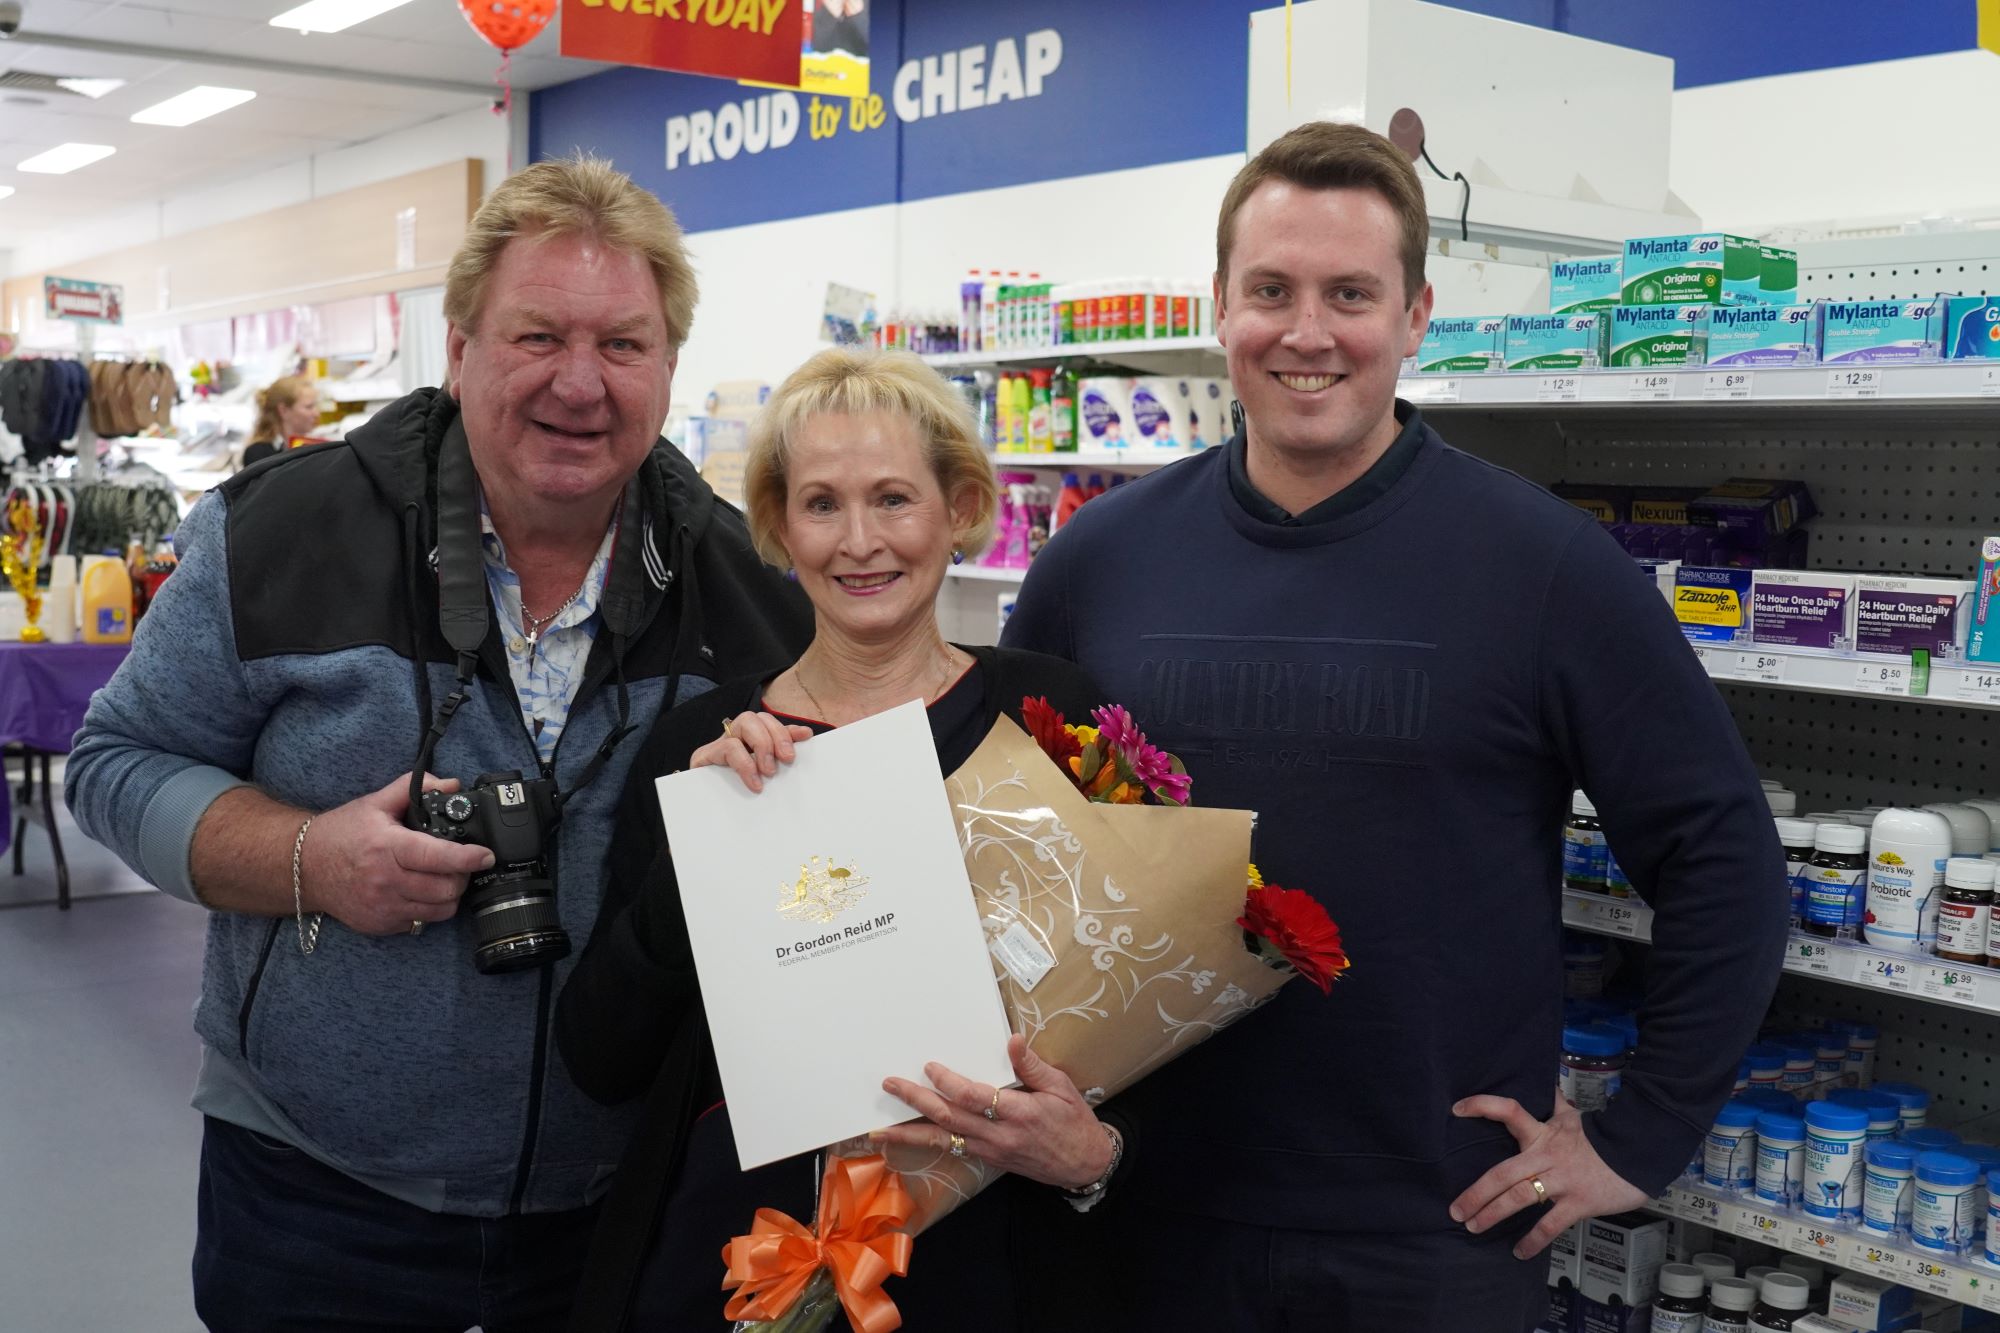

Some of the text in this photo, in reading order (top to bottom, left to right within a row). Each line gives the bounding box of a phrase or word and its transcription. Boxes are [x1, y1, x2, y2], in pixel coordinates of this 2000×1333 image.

[666, 29, 1063, 170] PROUD to be CHEAP
[1629, 240, 1688, 259] Mylanta
[1690, 238, 1719, 254] 2go
[1555, 262, 1612, 280] Mylanta
[1663, 273, 1701, 285] Original
[1616, 308, 1675, 326] Mylanta
[1713, 307, 1809, 330] Mylanta 2go
[1829, 302, 1936, 324] Mylanta 2go
[1427, 319, 1500, 339] Mylanta 2go
[1510, 317, 1593, 336] Mylanta 2go
[1636, 321, 1668, 331] ANTACID
[1735, 323, 1769, 332] ANTACID
[1852, 318, 1891, 329] ANTACID
[1652, 342, 1688, 354] Original
[1552, 379, 1574, 390] 12.99
[1644, 377, 1668, 388] 14.99
[1725, 375, 1745, 388] 6.99
[1846, 372, 1873, 385] 12.99
[1634, 502, 1688, 519] Nexium
[1679, 589, 1729, 604] Zanzole
[1755, 593, 1840, 610] 24 Hour Once Daily
[1715, 603, 1737, 613] 24HR
[1755, 603, 1828, 616] Heartburn Relief
[1860, 600, 1950, 617] 24 Hour Once Daily
[1859, 610, 1937, 624] Heartburn Relief
[1973, 630, 1984, 641] 14
[1757, 656, 1777, 669] 5.00
[1880, 668, 1901, 680] 8.50
[1977, 675, 2000, 688] 14.5
[1137, 657, 1430, 741] COUNTRY ROAD
[1871, 861, 1914, 877] Nature's Way
[1820, 884, 1847, 894] Restore
[1871, 881, 1912, 898] Probiotic
[1609, 907, 1632, 920] 15.99
[776, 913, 896, 958] Dr Gordon Reid MP
[778, 925, 898, 967] FEDERAL MEMBER FOR ROBERTSON
[1691, 1196, 1717, 1209] 29.99
[1752, 1214, 1778, 1229] 1899
[1834, 1292, 1875, 1308] BLACKMORES
